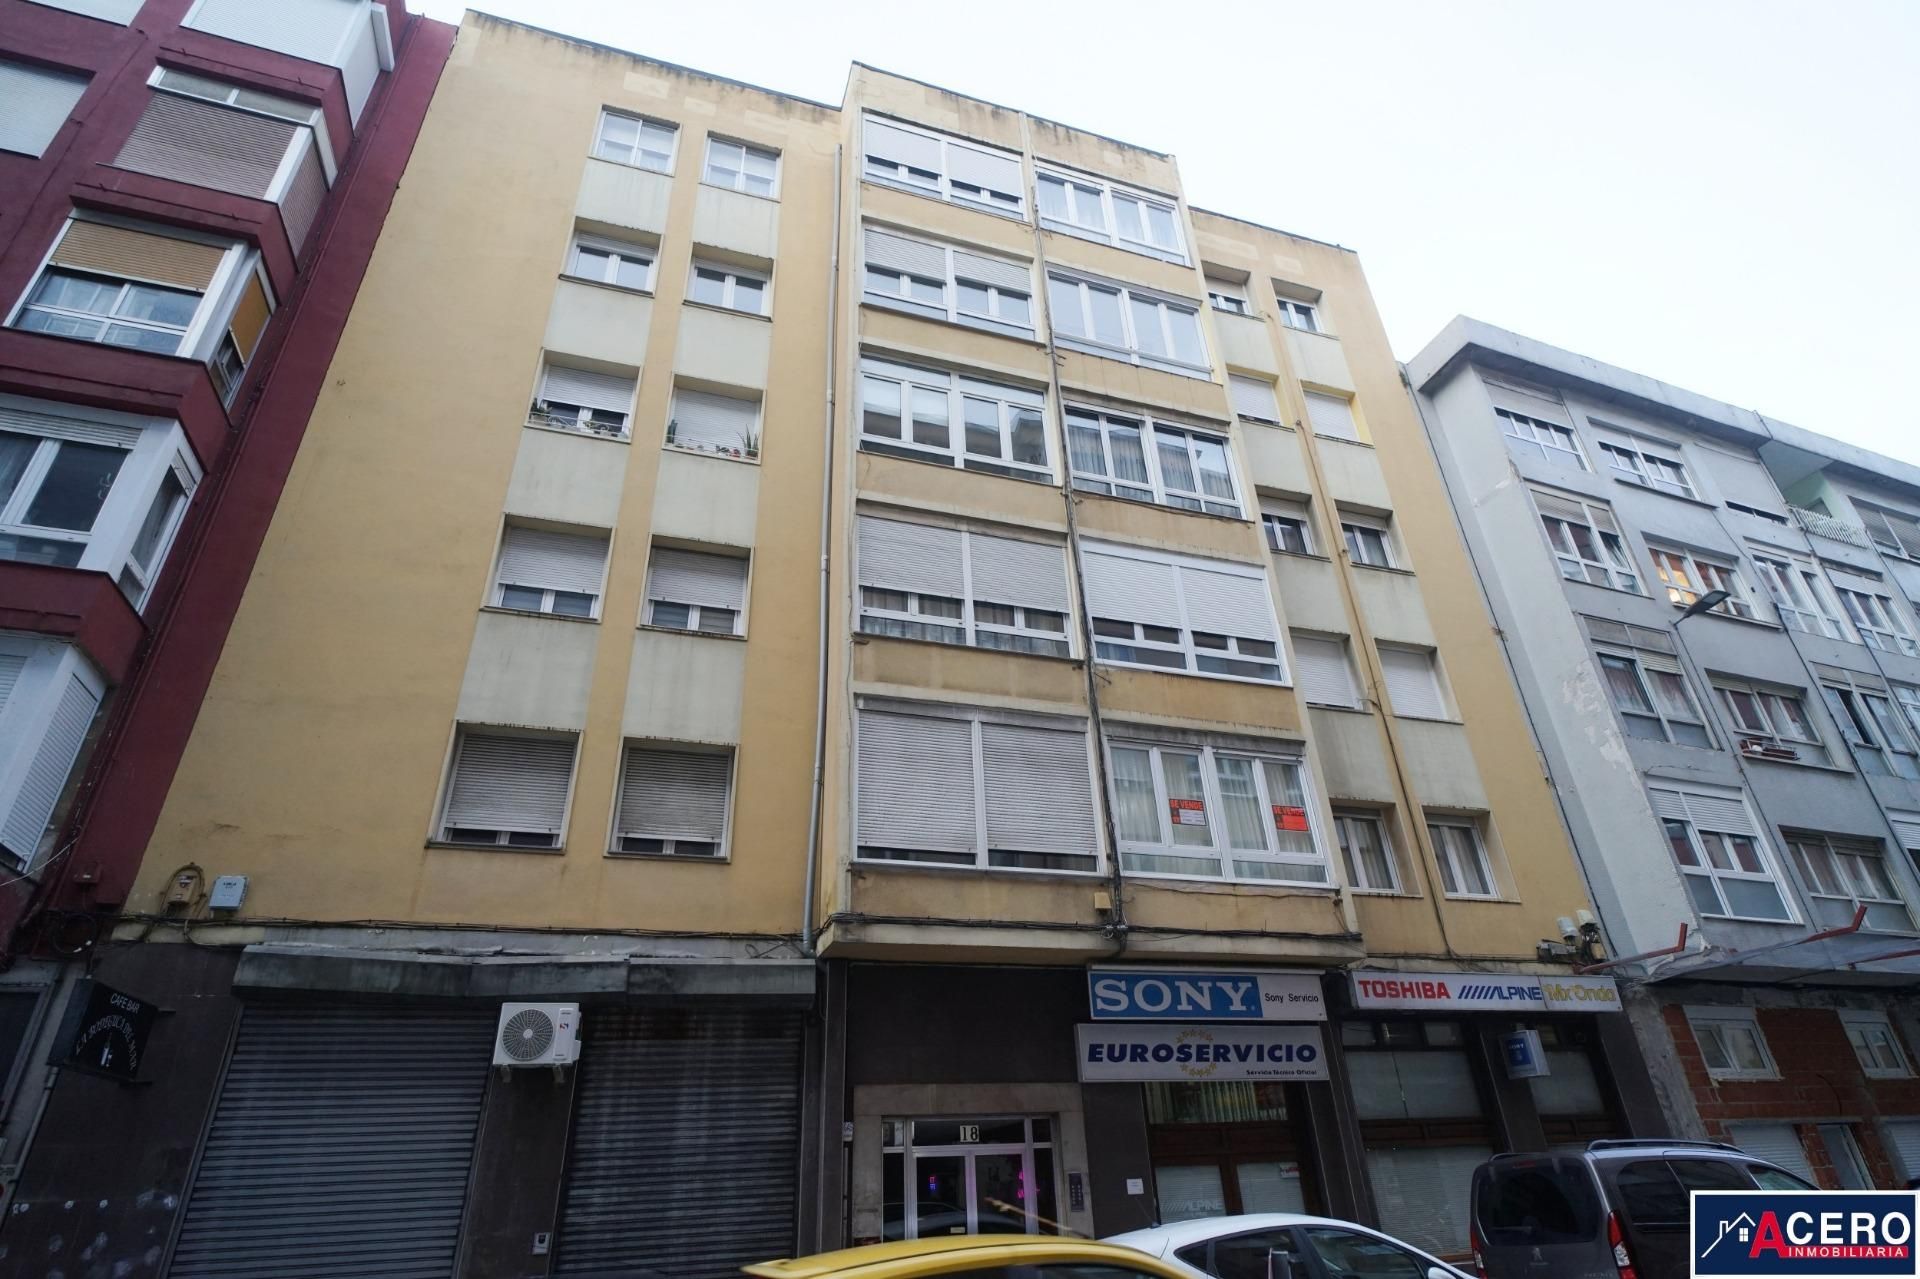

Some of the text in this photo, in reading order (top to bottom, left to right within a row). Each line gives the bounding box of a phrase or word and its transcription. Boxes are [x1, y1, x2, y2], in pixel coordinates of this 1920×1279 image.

[1180, 800, 1204, 810] VENDE
[1094, 979, 1252, 1012] SONY
[1358, 980, 1451, 999] TOSHIBA
[1264, 992, 1319, 1004] Sony Servicio
[126, 1000, 140, 1014] BAR
[1087, 1043, 1317, 1063] EUROSERVICIO
[961, 1126, 979, 1142] 18
